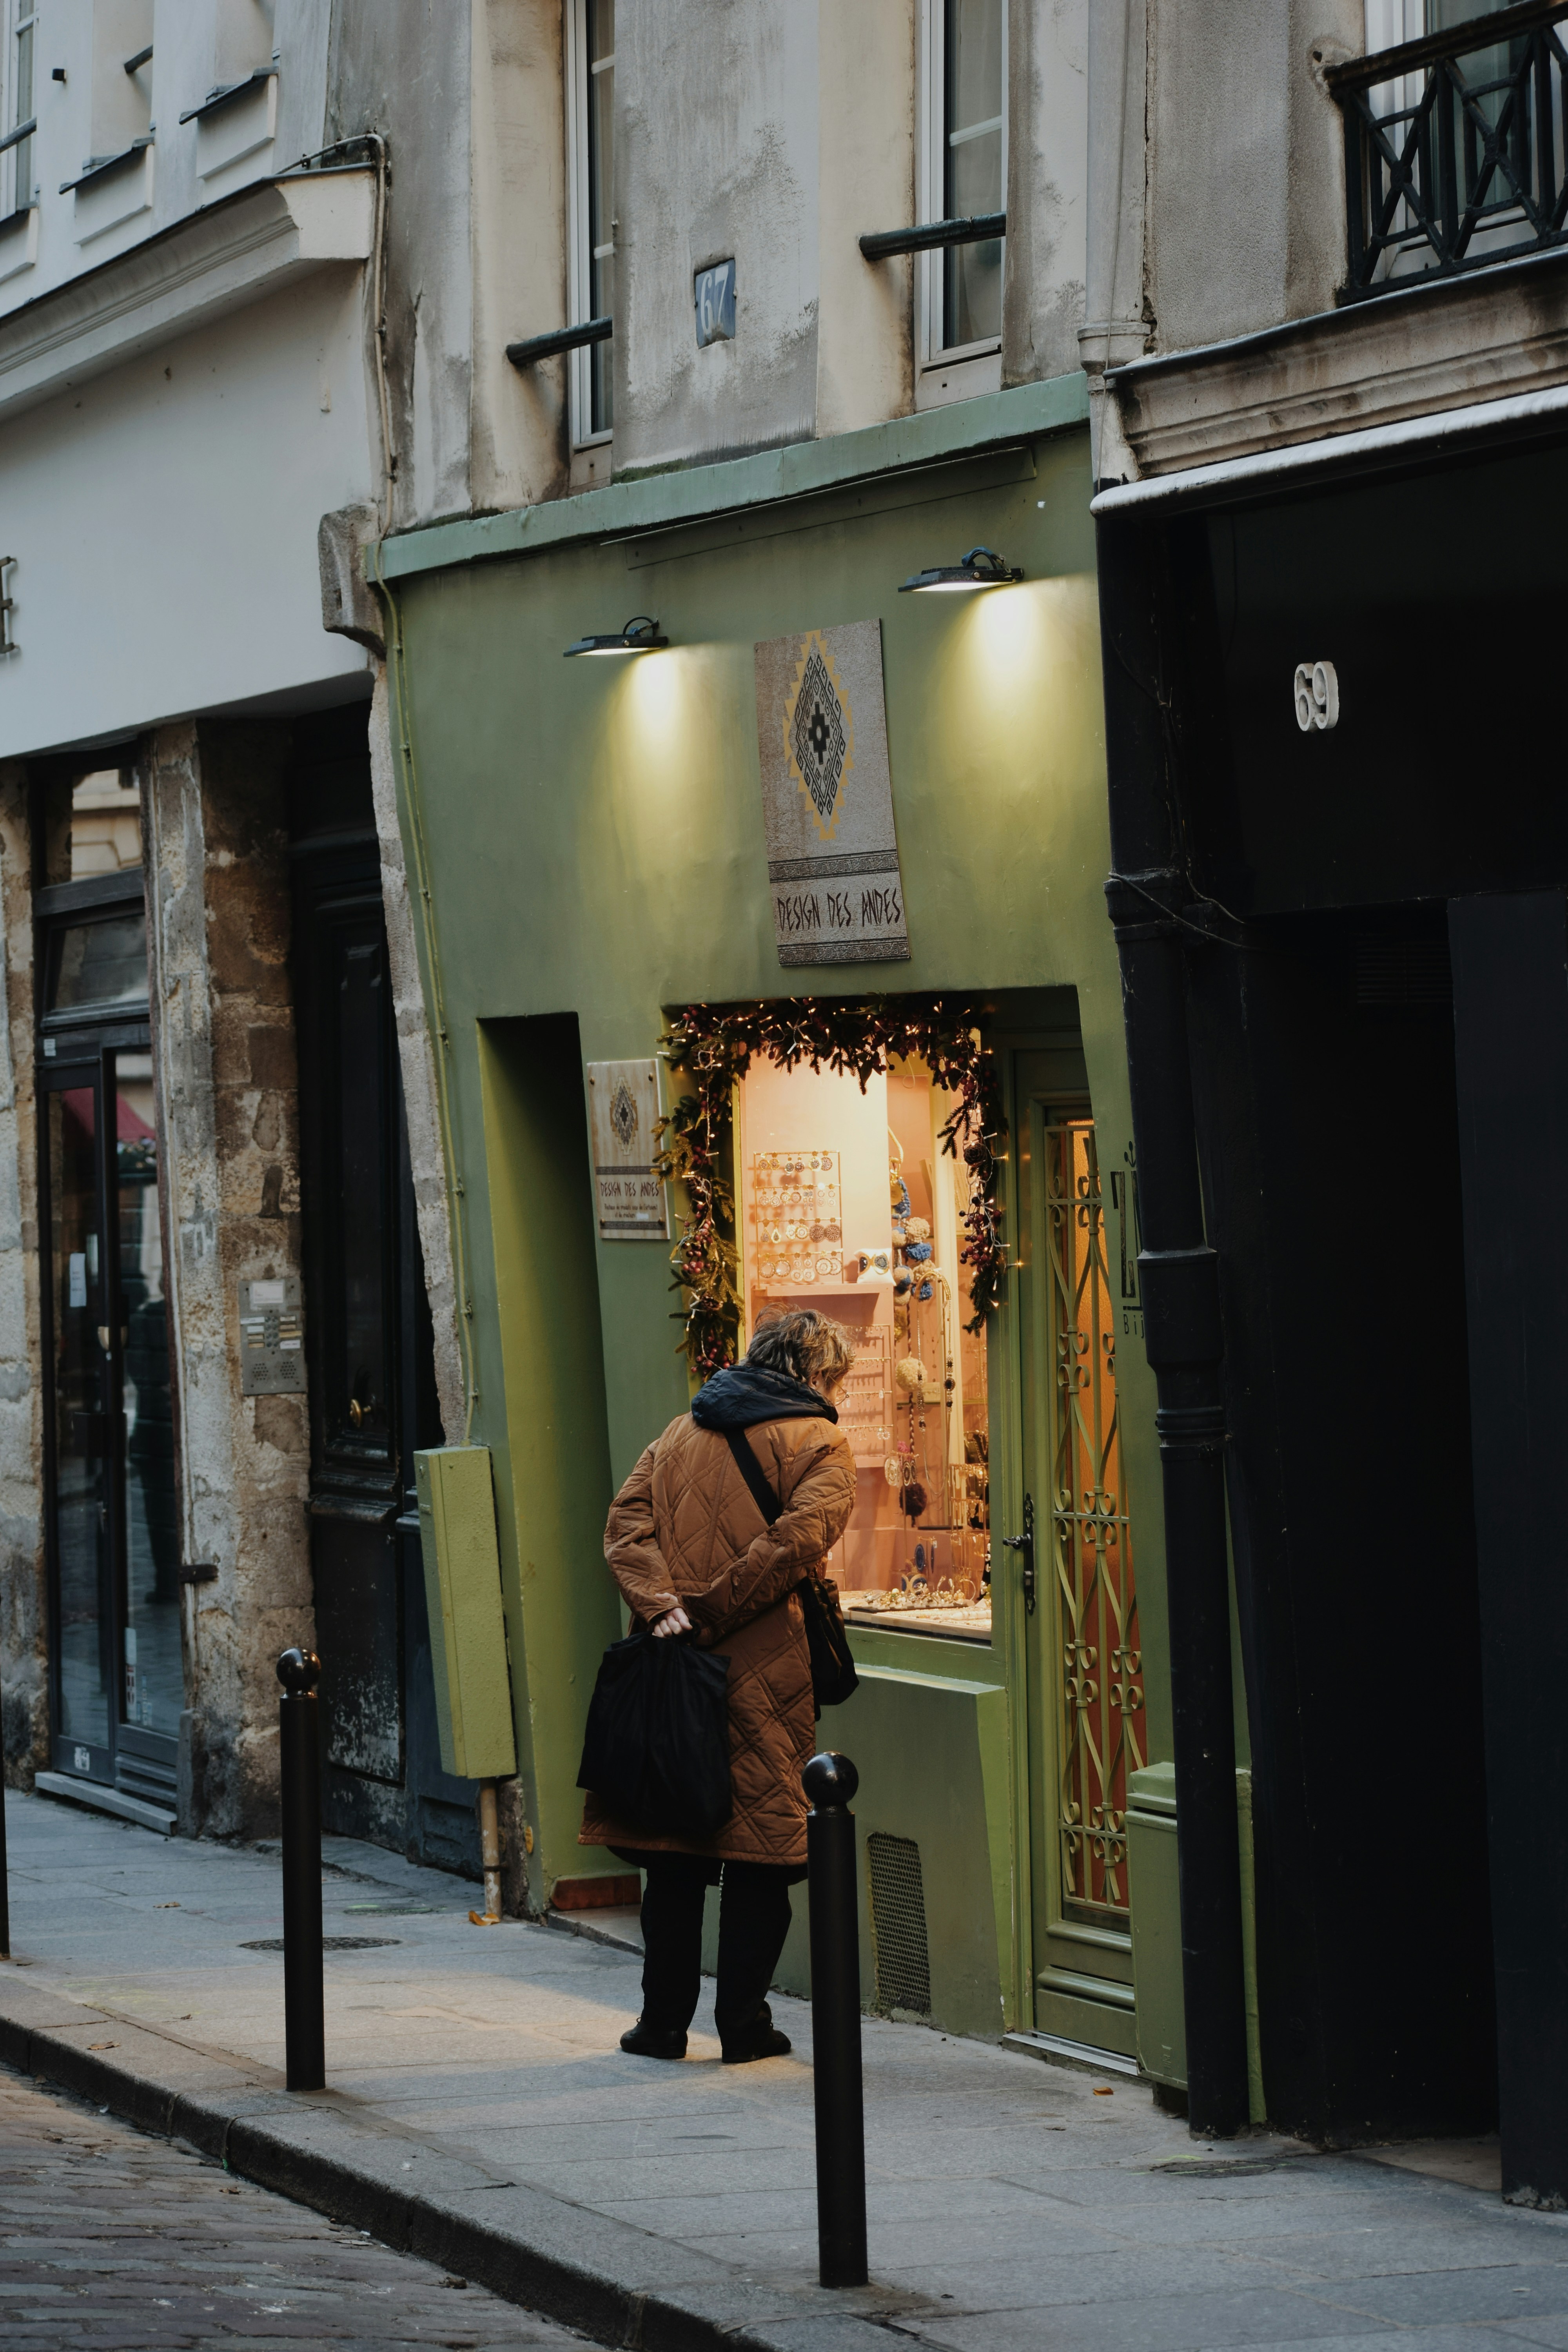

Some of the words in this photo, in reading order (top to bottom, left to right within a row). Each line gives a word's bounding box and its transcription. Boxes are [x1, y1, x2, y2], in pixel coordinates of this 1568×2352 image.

[700, 264, 729, 338] 67
[1294, 661, 1339, 731] 69
[777, 894, 821, 932] DESIGN
[826, 891, 851, 928] DES
[862, 887, 901, 927] ANDES
[600, 1181, 621, 1196] DESIGN
[624, 1181, 636, 1196] DES
[641, 1181, 659, 1196] ANDES
[1123, 1313, 1144, 1339] Bij
